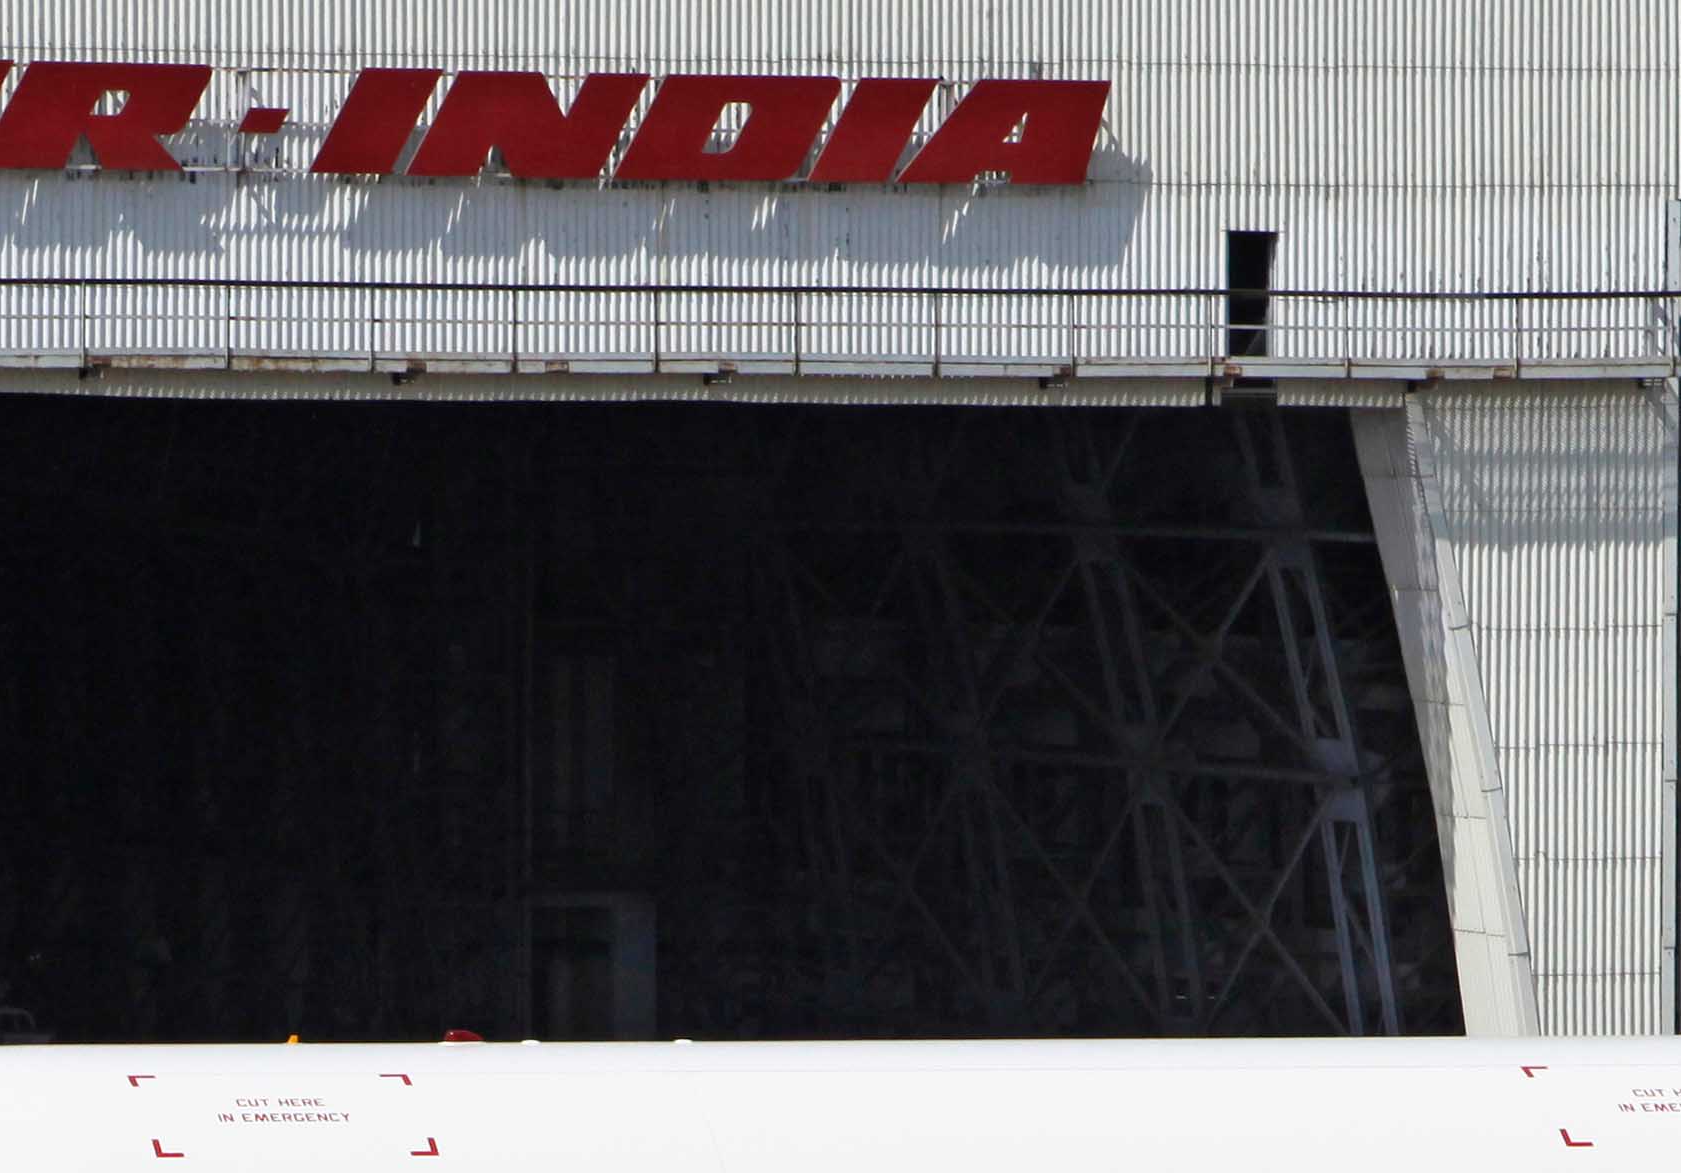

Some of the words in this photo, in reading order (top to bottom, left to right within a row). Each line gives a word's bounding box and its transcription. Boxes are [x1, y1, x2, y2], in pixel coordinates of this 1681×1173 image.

[1631, 1088, 1665, 1098] CUT
[234, 1097, 269, 1108] CUT
[278, 1097, 326, 1108] HERE
[1616, 1103, 1636, 1113] IN
[217, 1112, 235, 1123] IN
[240, 1112, 350, 1123] EMERGENCY
